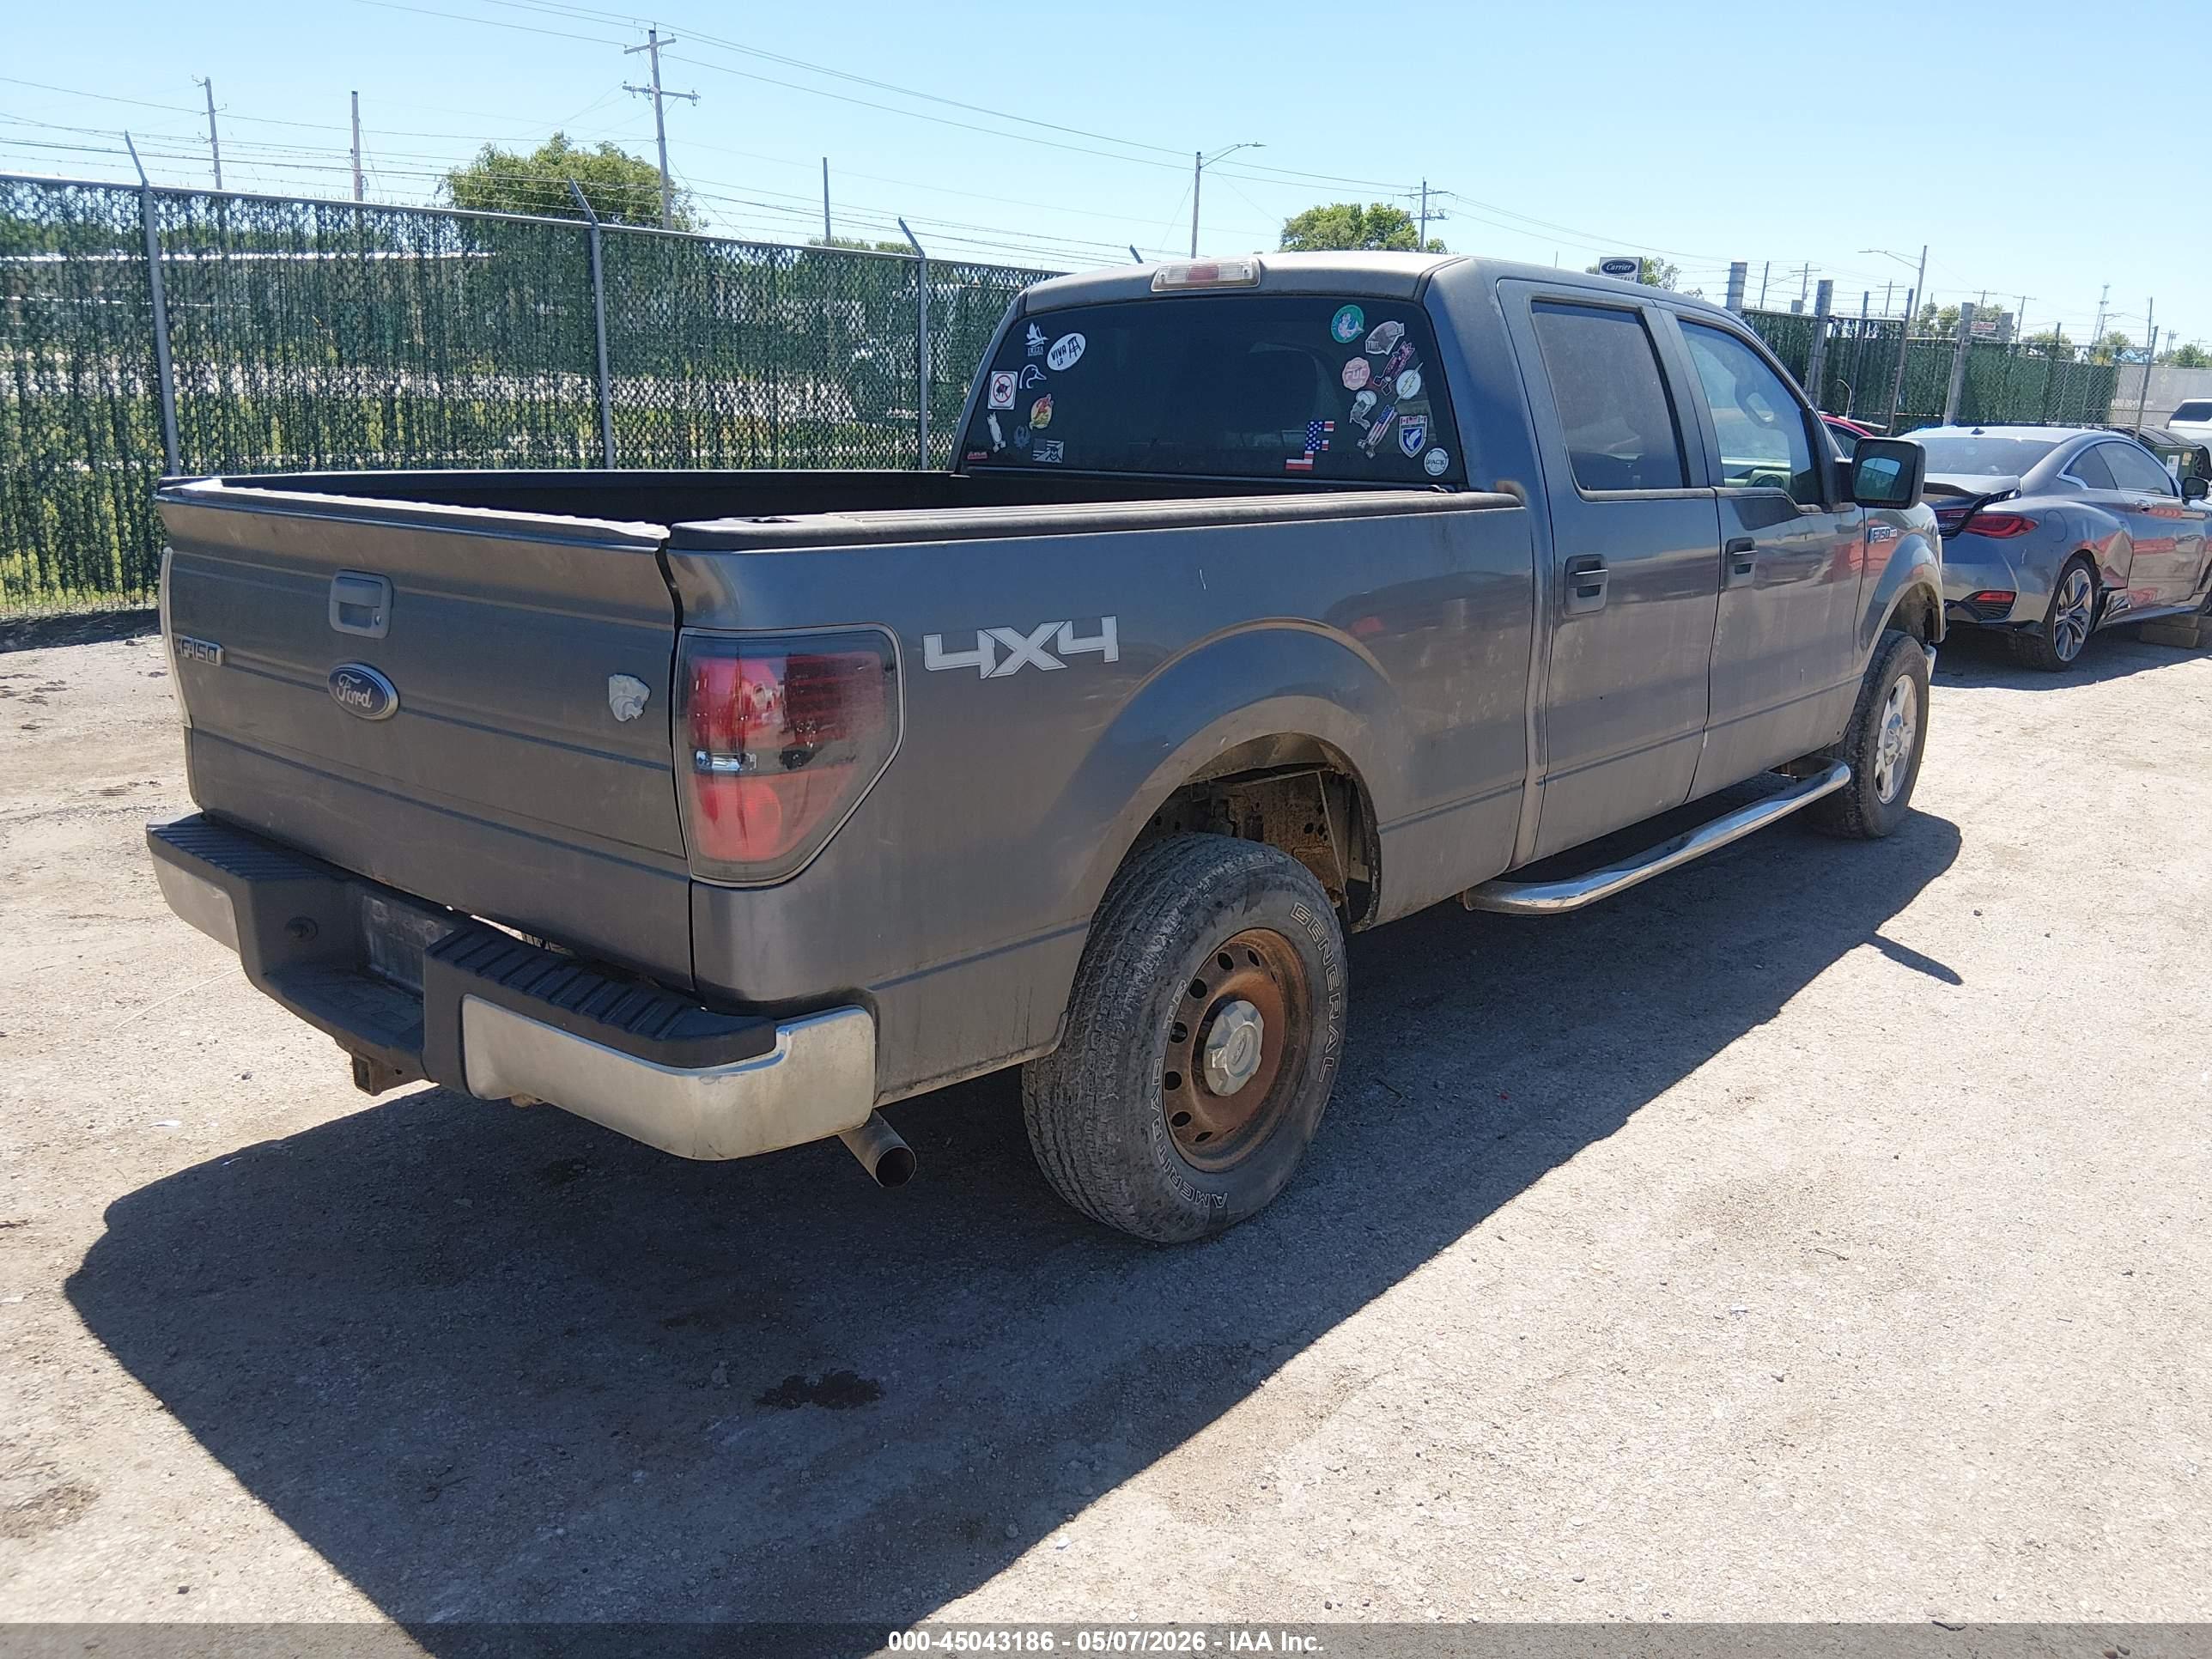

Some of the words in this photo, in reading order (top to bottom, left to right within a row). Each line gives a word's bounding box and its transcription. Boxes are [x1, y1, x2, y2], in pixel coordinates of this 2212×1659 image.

[1051, 345, 1067, 362] VIVA
[336, 673, 374, 708] Ford
[1291, 902, 1340, 1083] GENERAL
